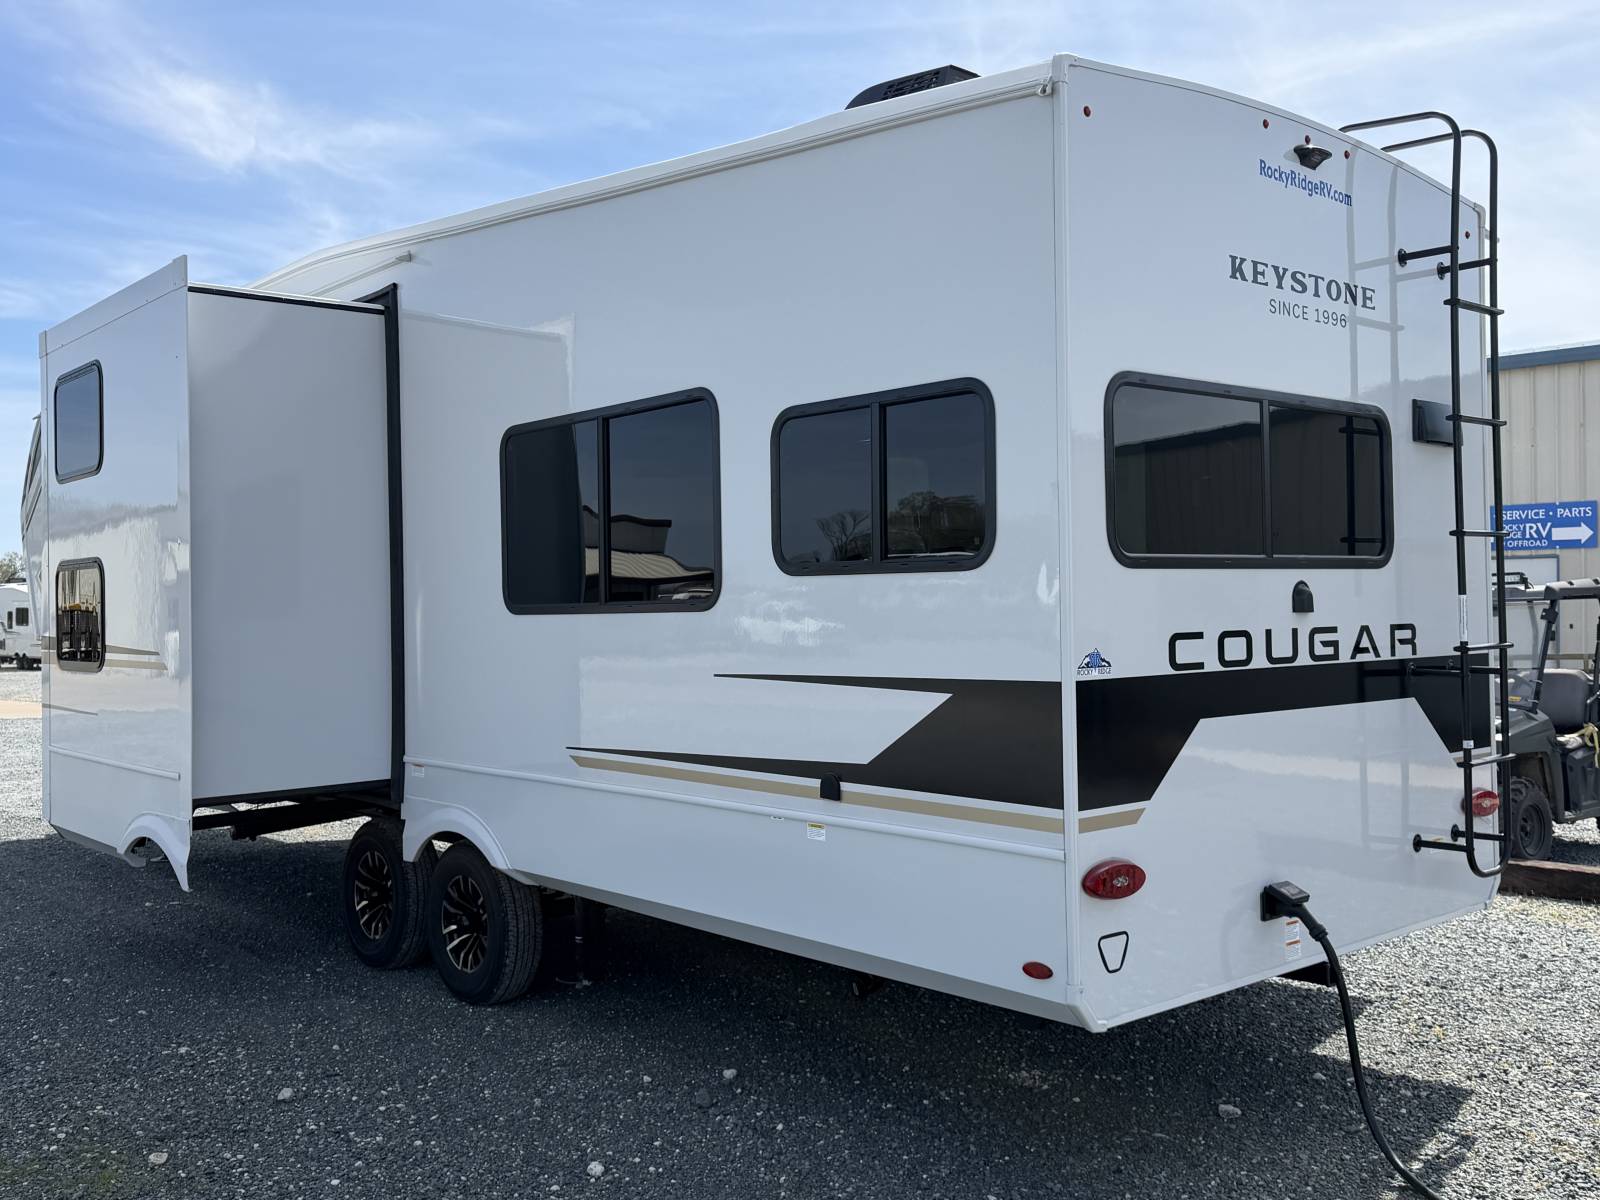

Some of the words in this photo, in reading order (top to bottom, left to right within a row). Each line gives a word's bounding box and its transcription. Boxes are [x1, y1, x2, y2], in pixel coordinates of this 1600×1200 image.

[1259, 159, 1353, 207] RockyRidgeRV.com
[1228, 254, 1377, 311] KEYSTONE
[1269, 298, 1309, 321] SINCE
[1314, 308, 1348, 329] 1996
[1557, 507, 1592, 518] PARTS
[1507, 540, 1548, 548] OFFROAD
[1525, 522, 1552, 539] RV
[1168, 623, 1418, 672] COUGAR
